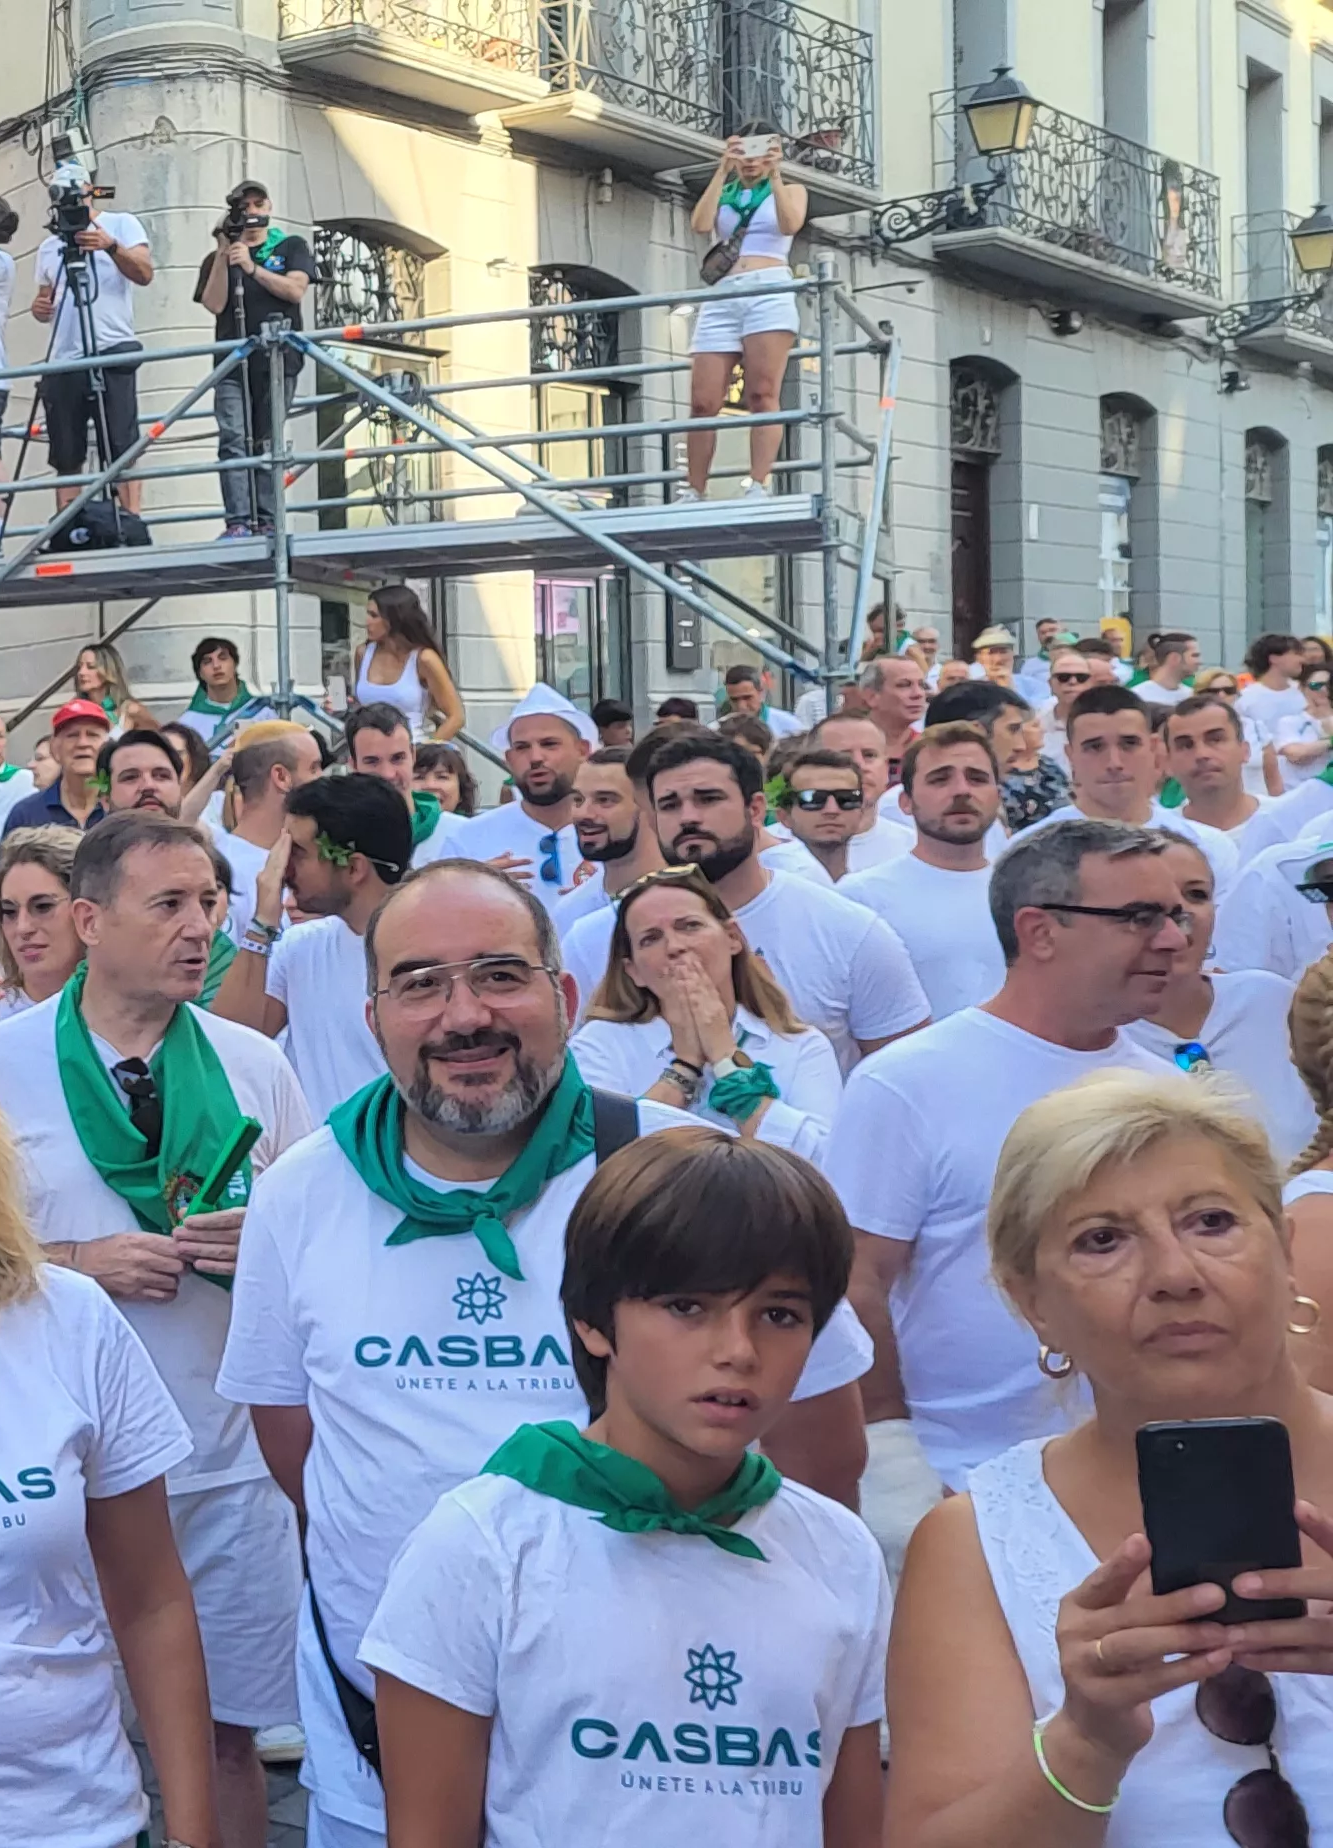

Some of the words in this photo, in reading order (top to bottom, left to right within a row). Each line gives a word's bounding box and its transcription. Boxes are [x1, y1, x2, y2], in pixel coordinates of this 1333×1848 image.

[354, 1334, 571, 1368] CASBA
[395, 1375, 458, 1391] ÚNETE
[467, 1379, 478, 1391] A
[487, 1379, 509, 1391] LA
[517, 1378, 576, 1391] TRIBU
[621, 1771, 696, 1794] ÚNETE
[719, 1781, 744, 1796] LA
